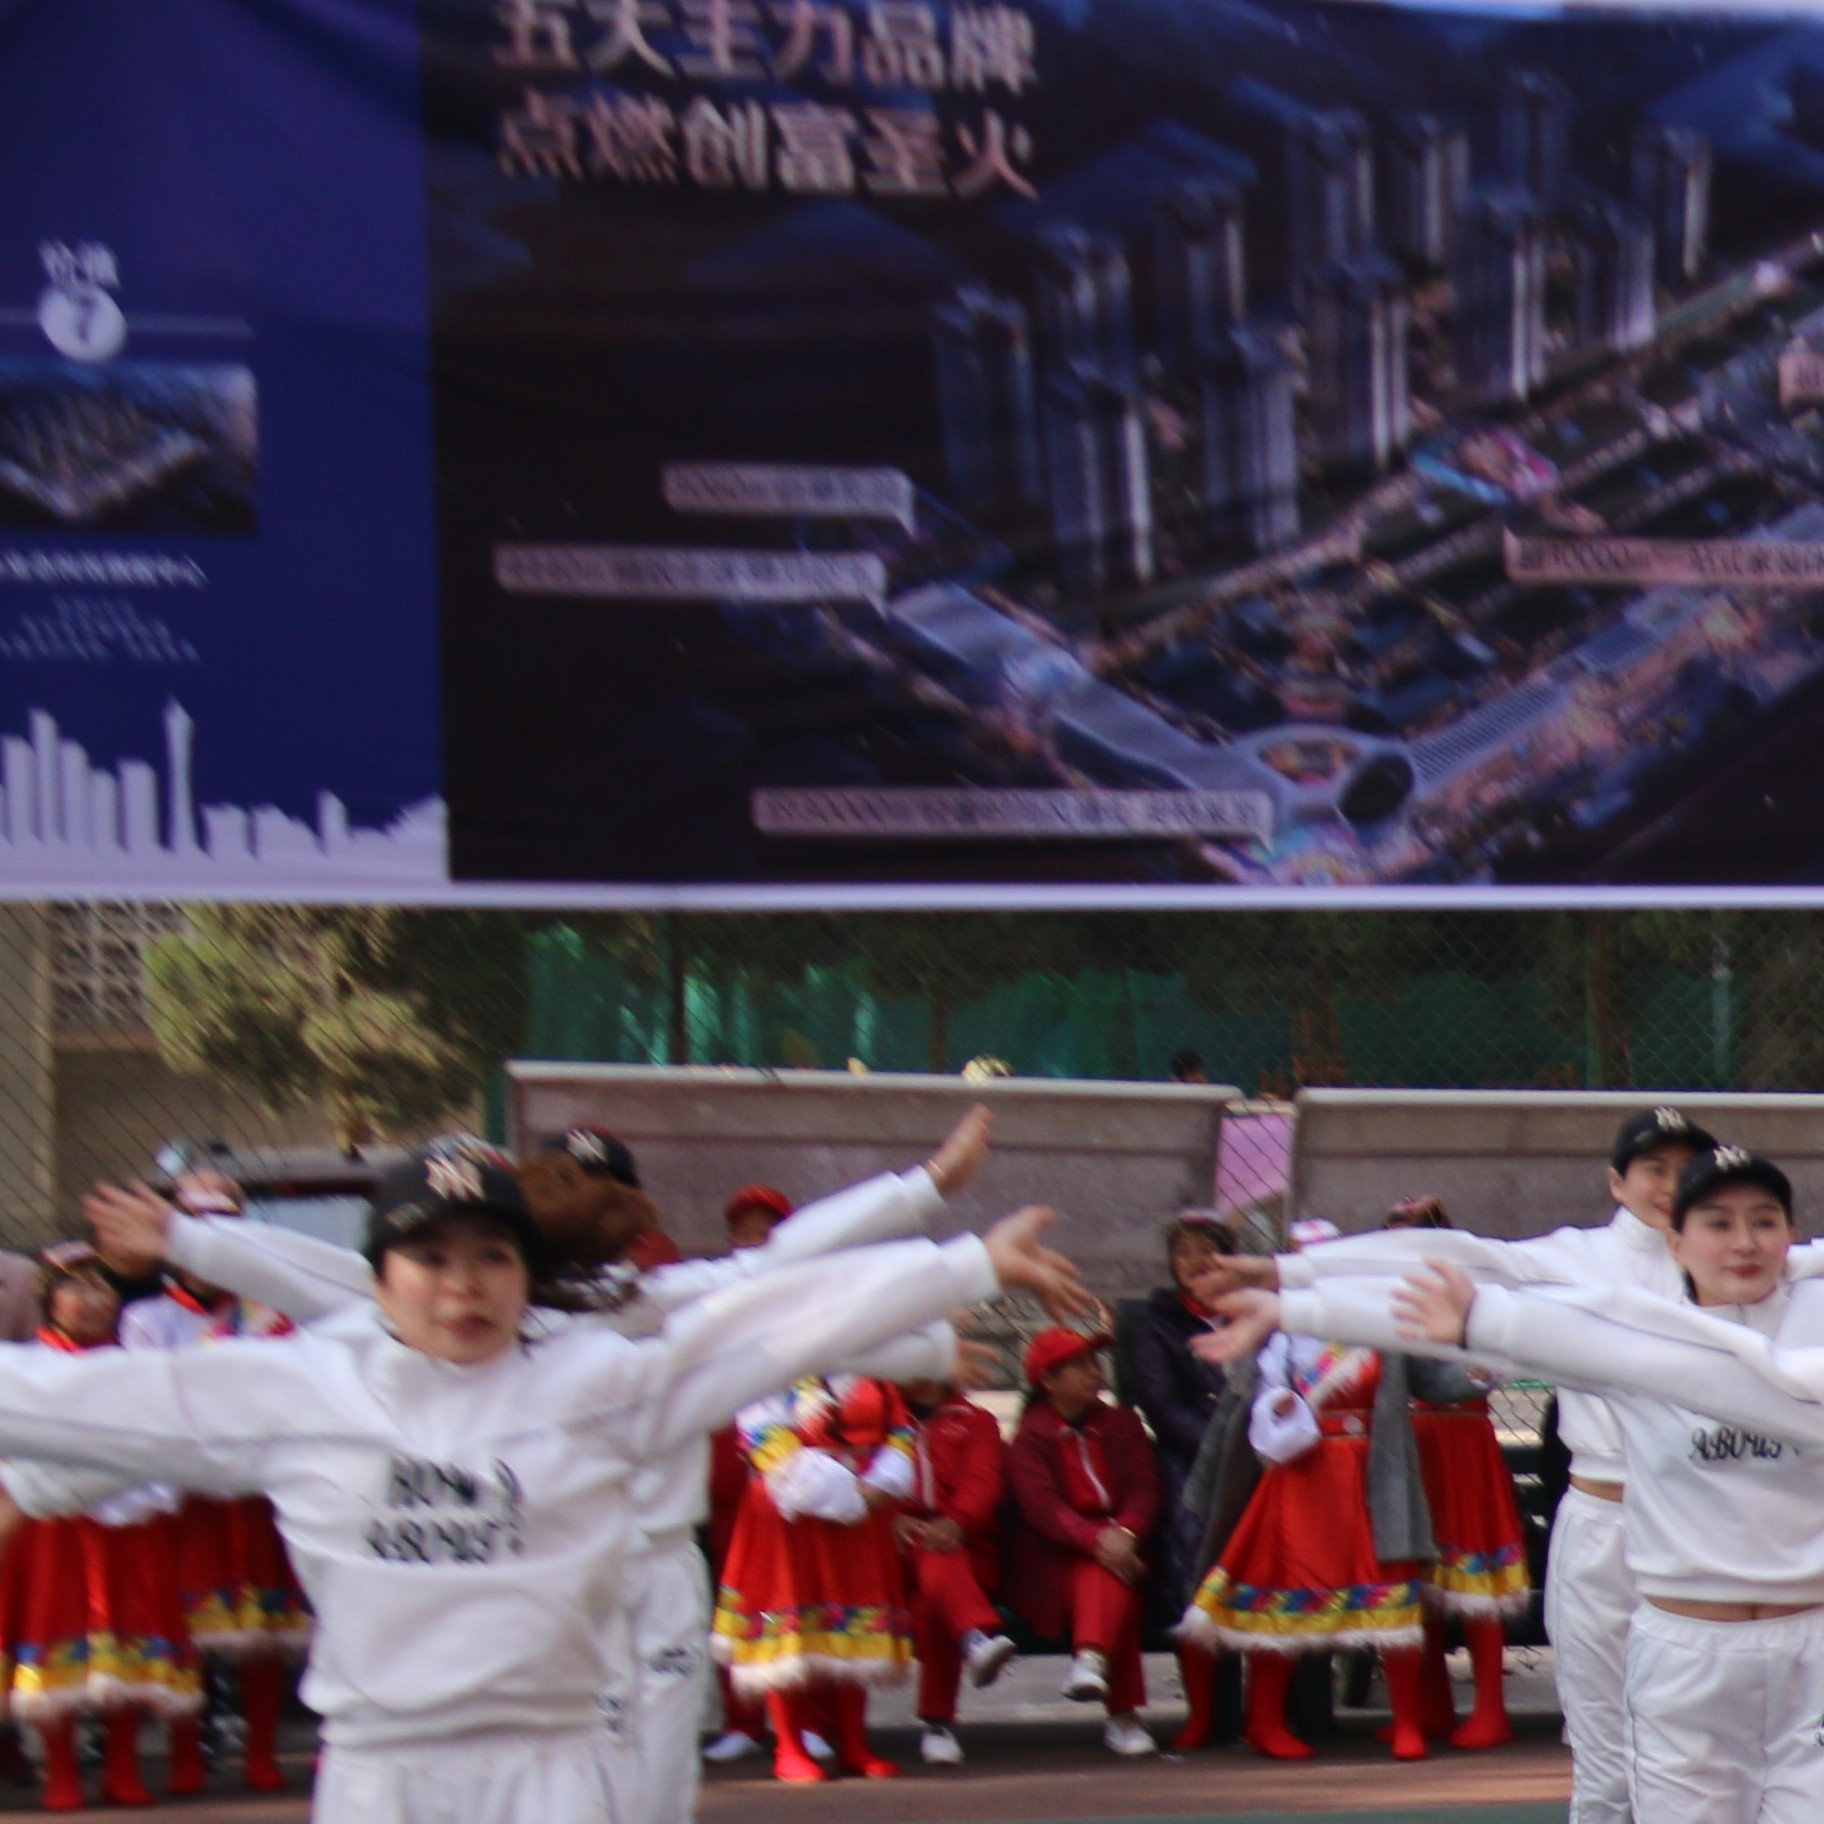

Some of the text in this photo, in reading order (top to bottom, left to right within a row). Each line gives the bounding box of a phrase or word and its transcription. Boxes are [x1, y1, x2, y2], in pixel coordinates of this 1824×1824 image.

[492, 0, 1037, 96] 五大主力品牌
